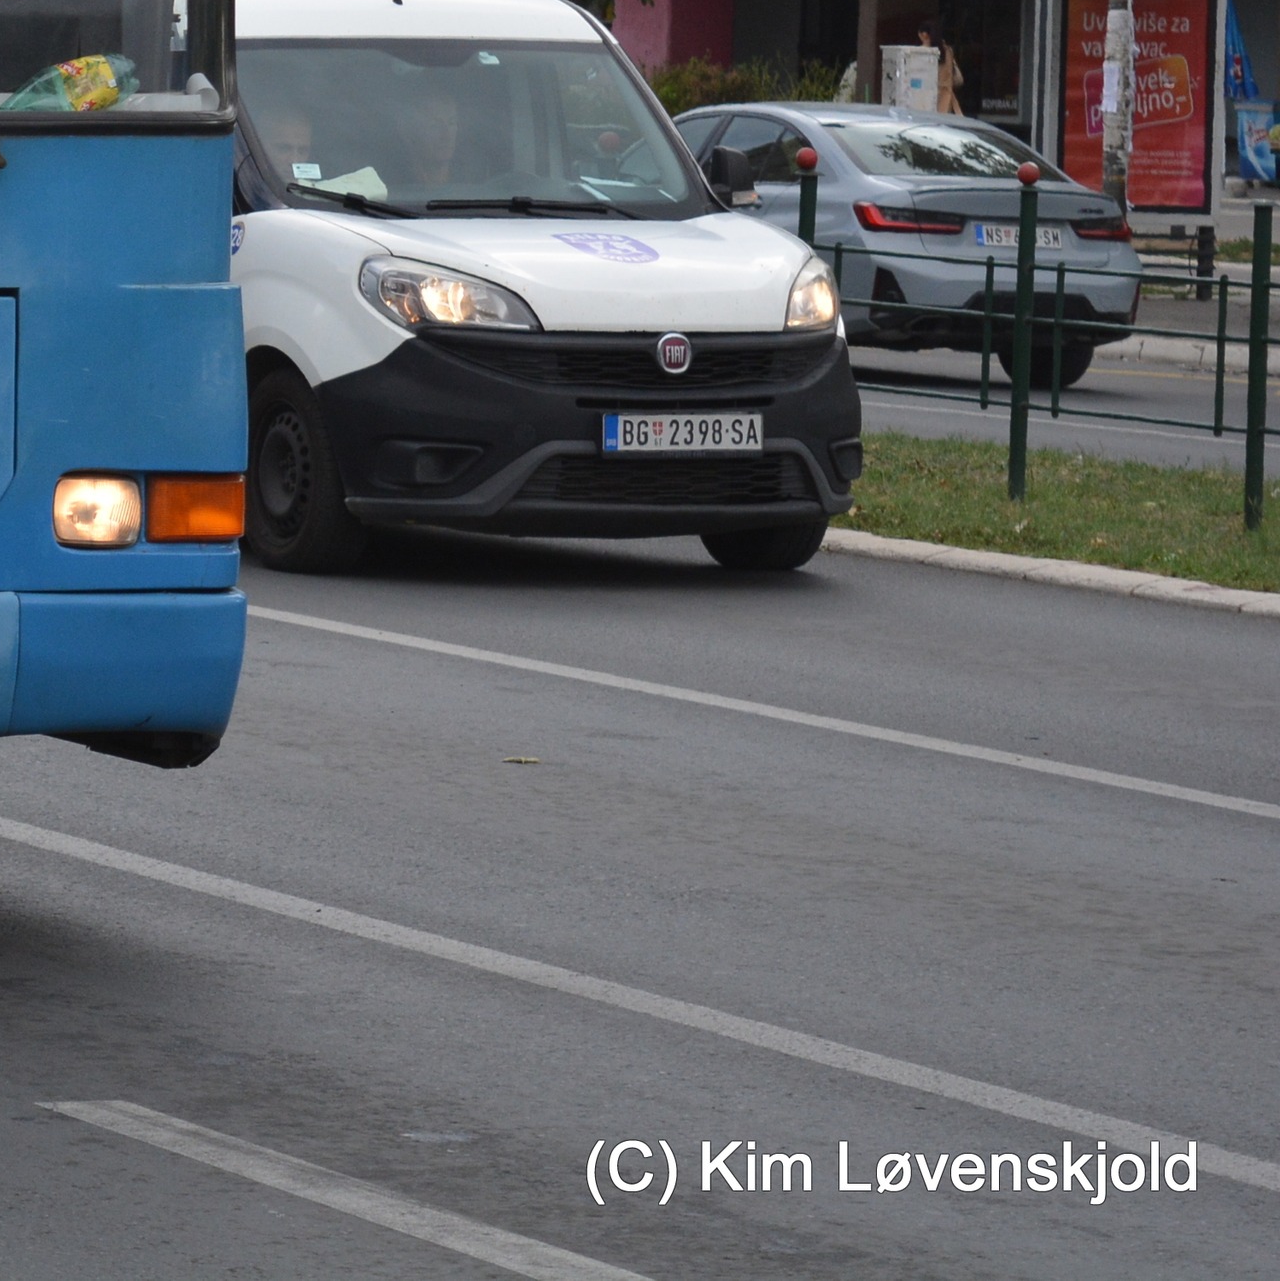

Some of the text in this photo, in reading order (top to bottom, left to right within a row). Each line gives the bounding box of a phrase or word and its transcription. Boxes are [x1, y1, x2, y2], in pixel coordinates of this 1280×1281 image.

[1170, 17, 1190, 33] za
[985, 227, 1003, 246] NS
[665, 345, 686, 364] FIAT
[622, 420, 649, 446] BG
